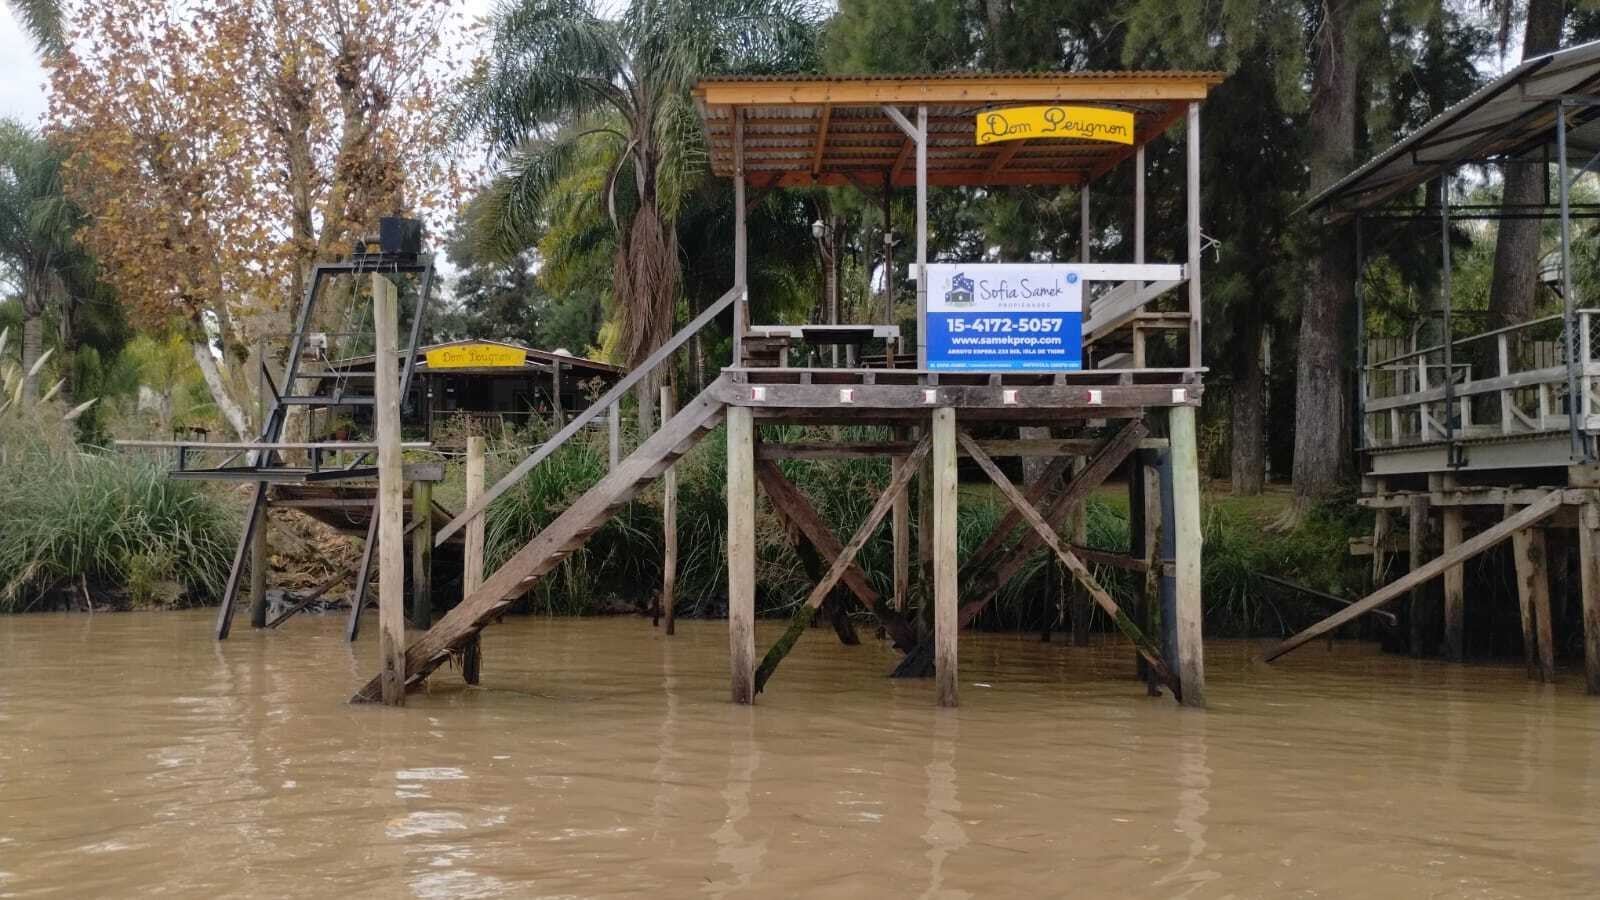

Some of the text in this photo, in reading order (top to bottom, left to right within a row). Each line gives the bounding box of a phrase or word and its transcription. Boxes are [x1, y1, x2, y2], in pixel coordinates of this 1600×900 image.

[981, 107, 1127, 142] Dom Perignon
[1020, 278, 1063, 299] Samek
[946, 318, 1063, 332] 15-4172-5057
[951, 335, 1062, 346] www.samekprop.com
